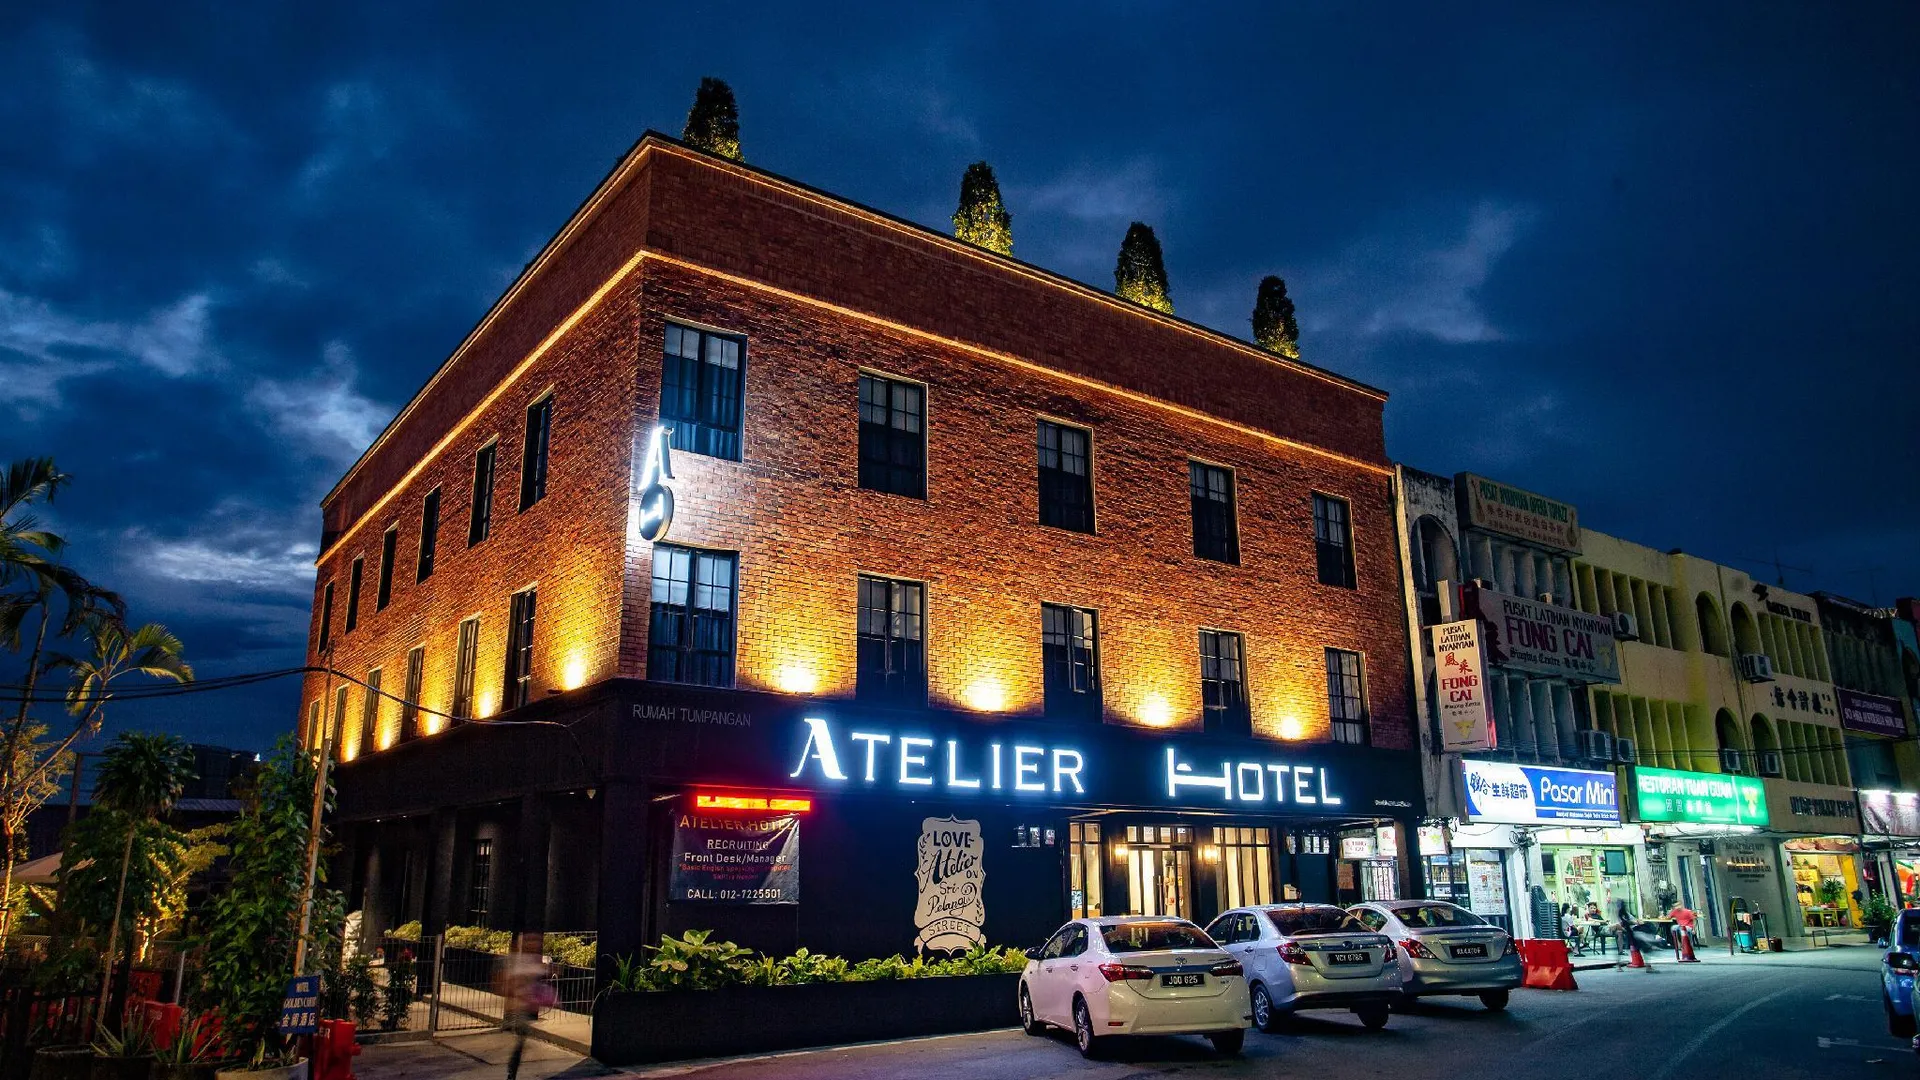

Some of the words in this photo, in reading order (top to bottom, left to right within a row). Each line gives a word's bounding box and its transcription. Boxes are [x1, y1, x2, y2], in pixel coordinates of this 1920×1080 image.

[1503, 599, 1531, 619] PUSAT
[1535, 606, 1570, 627] LATIHAN
[1572, 615, 1612, 636] NYANYIAN
[1441, 632, 1471, 643] LATIHAN
[1443, 624, 1466, 636] PUSAT
[1504, 615, 1558, 653] FONG
[1563, 629, 1595, 660] CAI
[1439, 640, 1474, 653] NYANYIAN
[1442, 675, 1478, 690] FONG
[1450, 689, 1473, 703] CAI
[633, 704, 676, 721] RUMAH
[680, 707, 751, 727] TUMPANGAN
[789, 717, 1086, 793] ATELIER
[1166, 748, 1341, 804] HOTEL
[1540, 776, 1583, 804] Pasar
[1586, 780, 1616, 806] Mini
[680, 814, 744, 830] ATELIER
[707, 839, 769, 851] RECRUITING
[933, 831, 974, 848] LOVE
[684, 852, 713, 863] Front
[716, 853, 786, 865] Desk/Manager
[920, 849, 978, 893] Atelier
[687, 889, 718, 899] CALL:
[720, 889, 781, 899] 012-7225501
[940, 881, 959, 895] Sri
[928, 920, 971, 936] STREET
[1184, 975, 1198, 984] 625
